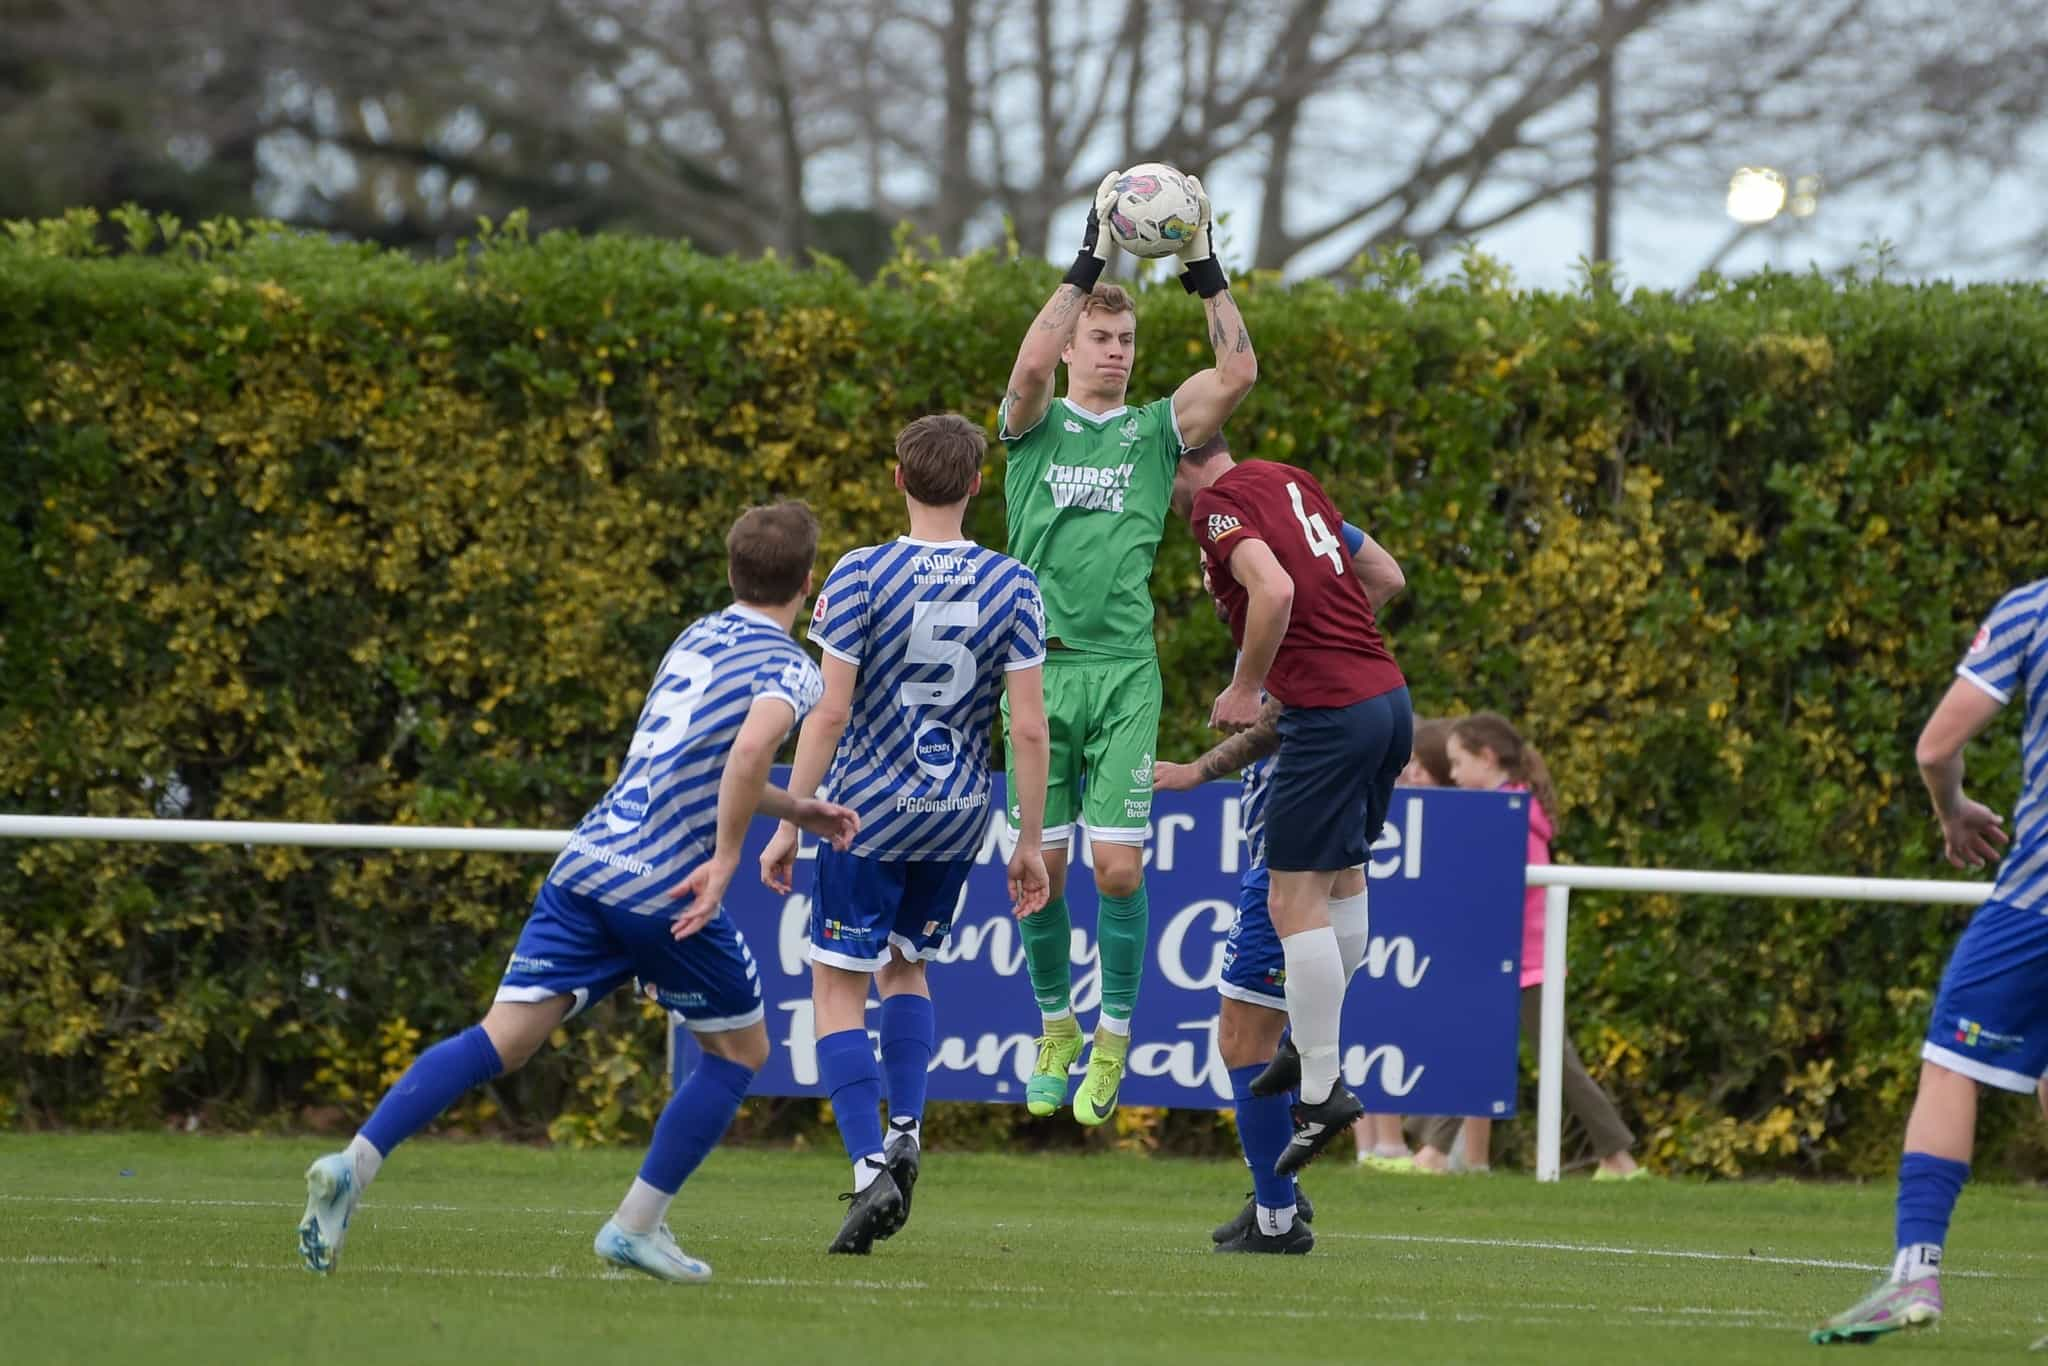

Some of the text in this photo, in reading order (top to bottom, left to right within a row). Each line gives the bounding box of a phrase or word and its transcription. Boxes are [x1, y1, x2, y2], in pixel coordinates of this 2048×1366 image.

[1044, 463, 1135, 488] THIRSTY
[1050, 483, 1124, 513] WHALE
[1286, 481, 1344, 577] 4
[911, 554, 977, 574] PADDY'S
[901, 601, 979, 706] 5
[626, 650, 713, 758] 3
[896, 792, 987, 813] PGConstructors
